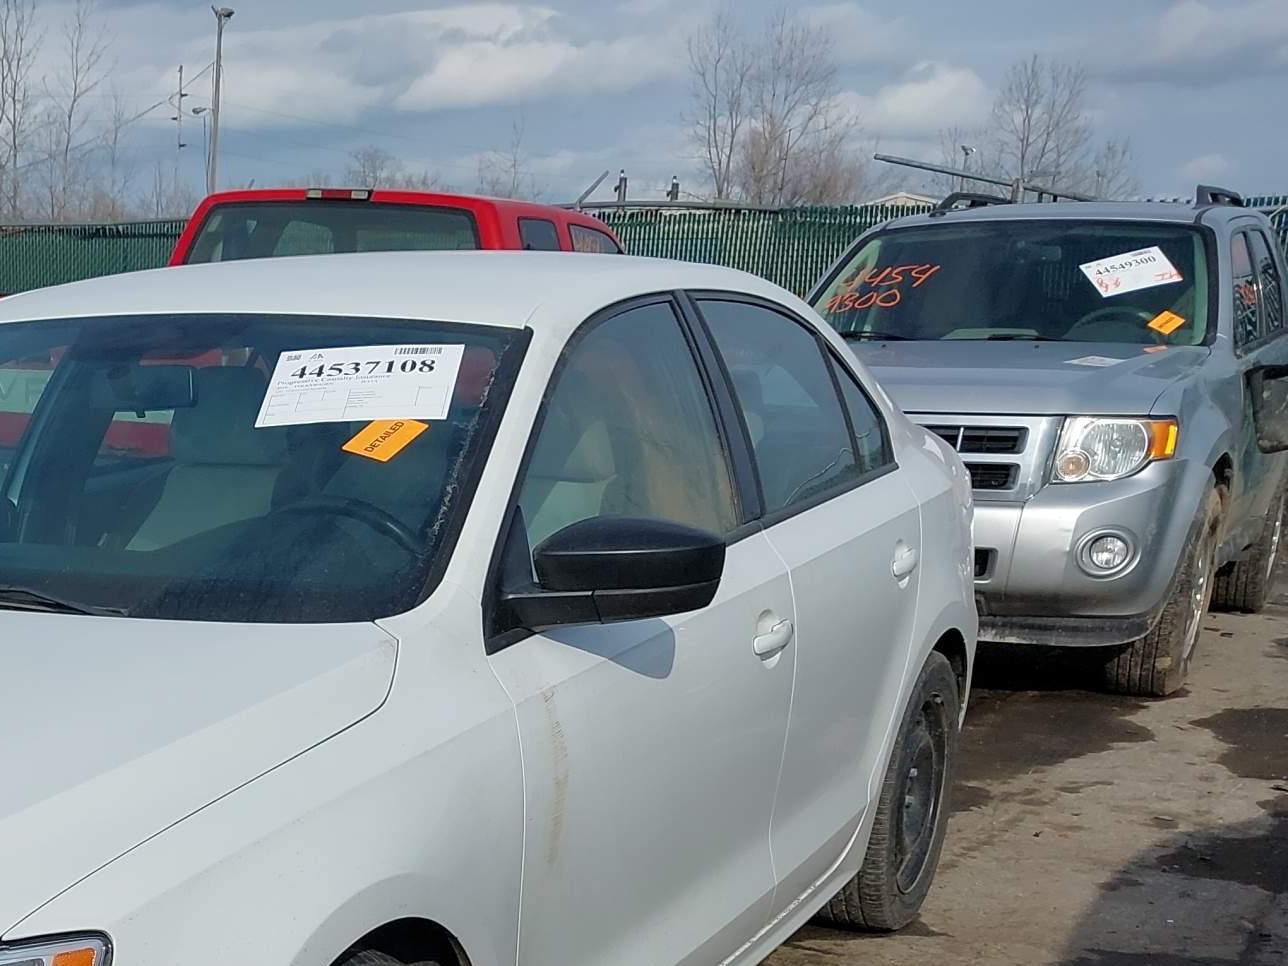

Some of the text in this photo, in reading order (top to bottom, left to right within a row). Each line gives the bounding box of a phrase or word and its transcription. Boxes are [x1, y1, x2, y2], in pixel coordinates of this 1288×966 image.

[1095, 255, 1157, 276] 44549300
[290, 359, 436, 379] 44537108
[364, 421, 405, 453] DETAILED
